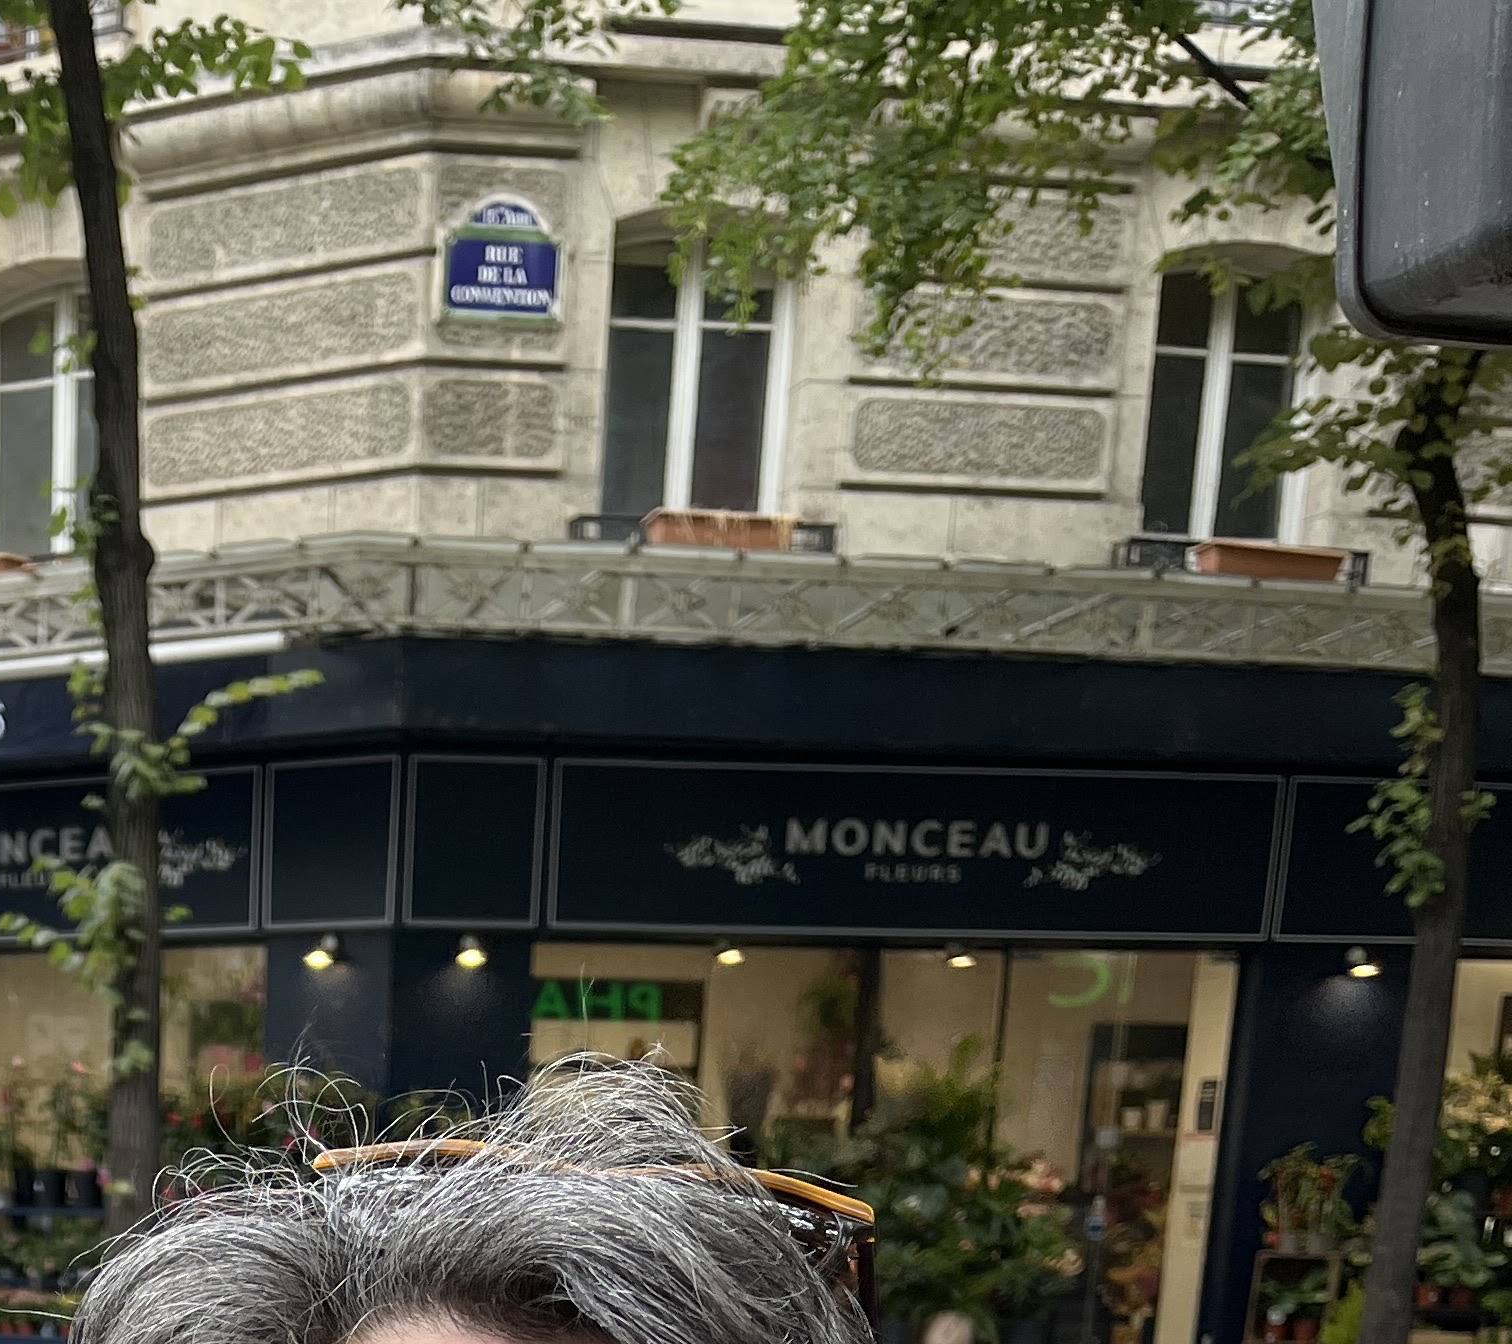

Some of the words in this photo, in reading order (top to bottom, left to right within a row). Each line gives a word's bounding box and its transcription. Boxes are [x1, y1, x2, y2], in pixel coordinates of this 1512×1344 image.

[484, 245, 524, 265] RUE
[477, 264, 502, 285] DE
[503, 266, 528, 286] LA
[450, 284, 552, 307] CONVENTION
[784, 815, 1051, 860] MONCEAU
[863, 861, 963, 884] FLEURS
